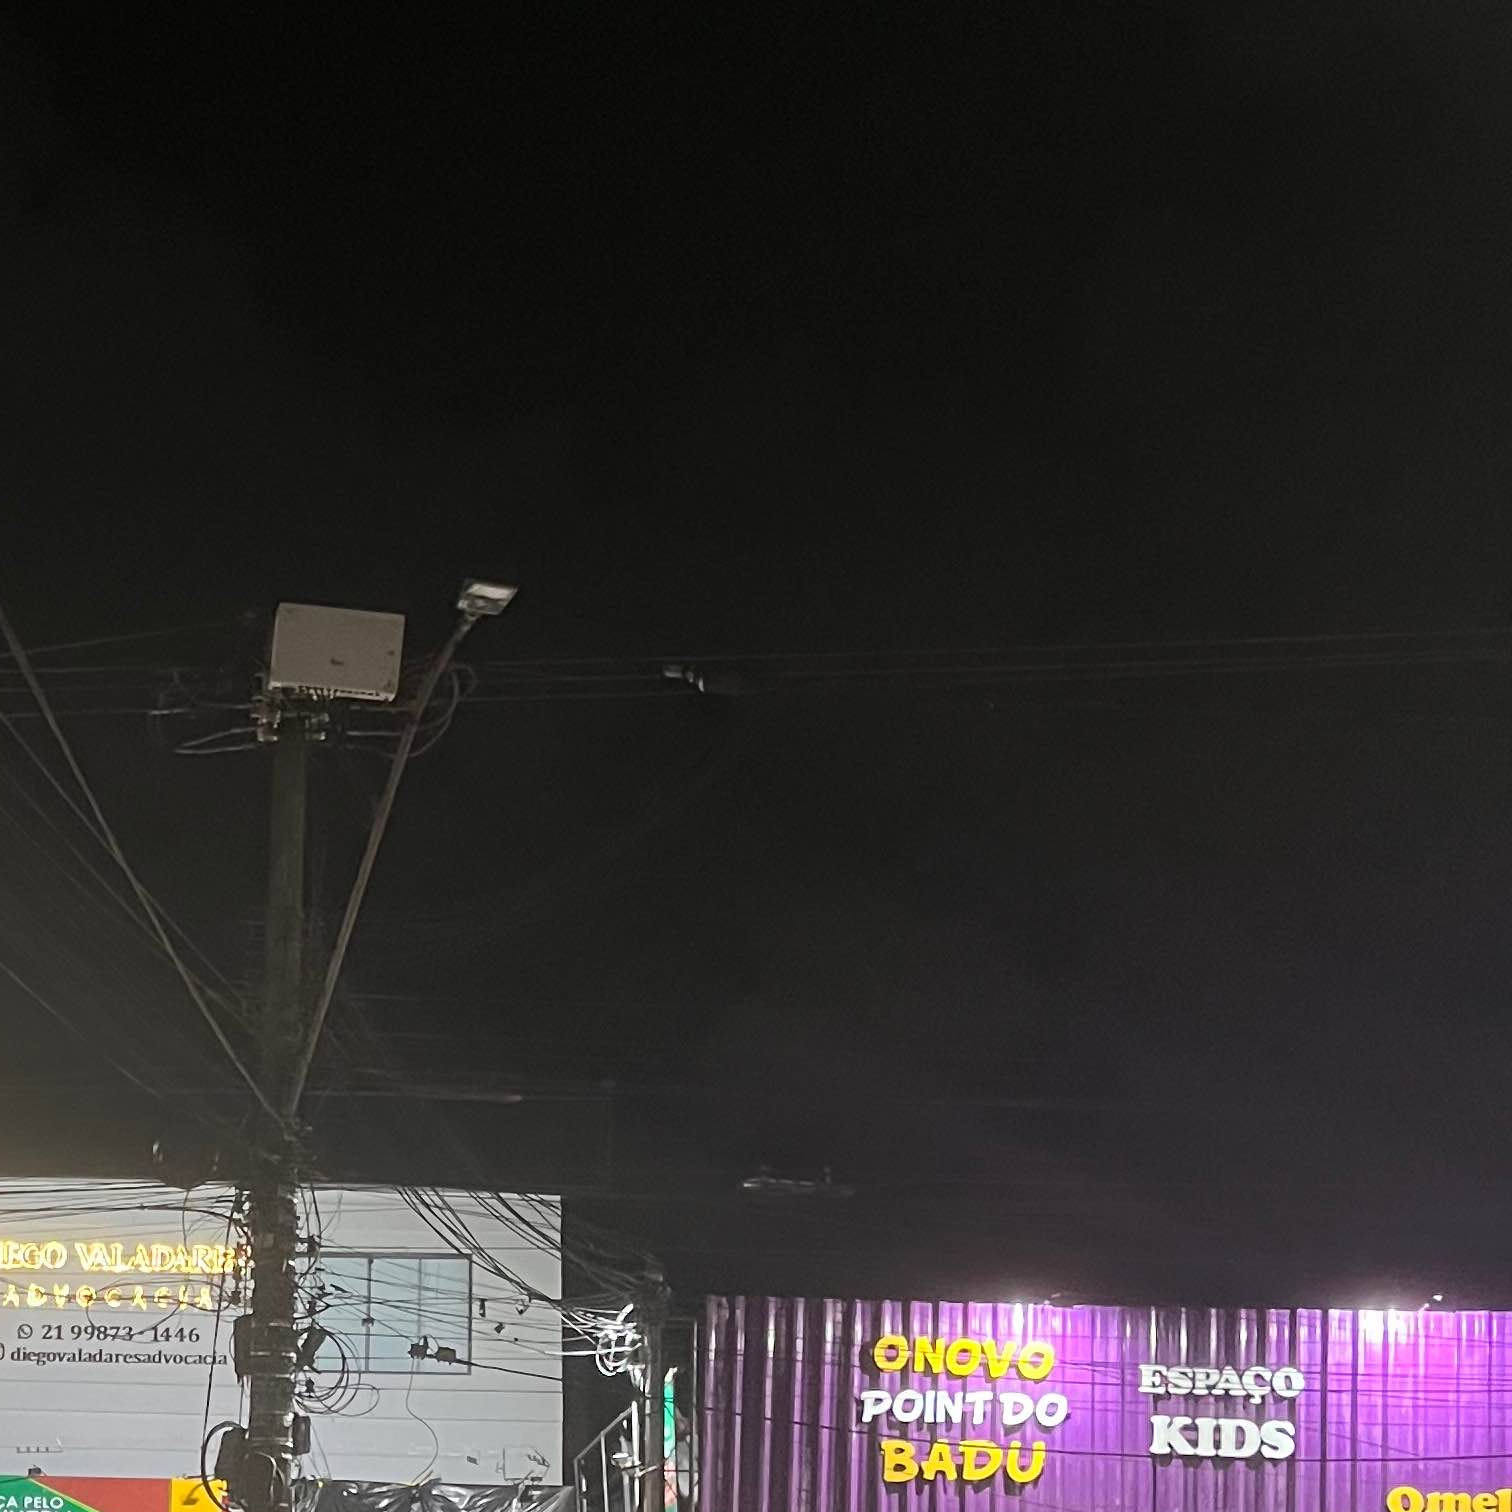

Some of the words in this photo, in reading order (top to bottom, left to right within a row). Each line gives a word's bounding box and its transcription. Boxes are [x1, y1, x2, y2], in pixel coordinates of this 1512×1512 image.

[75, 1242, 248, 1274] VALADARE
[2, 1282, 213, 1311] ADVOCACIA
[41, 1324, 64, 1340] 21
[10, 1347, 228, 1366] diegovaladaresadvocacia
[1139, 1364, 1305, 1405] ESPAÇO
[860, 1389, 994, 1426] POINT
[999, 1393, 1069, 1427] DO
[1150, 1415, 1296, 1460] KIDS
[880, 1438, 1046, 1483] BADU
[24, 1496, 63, 1509] PELO
